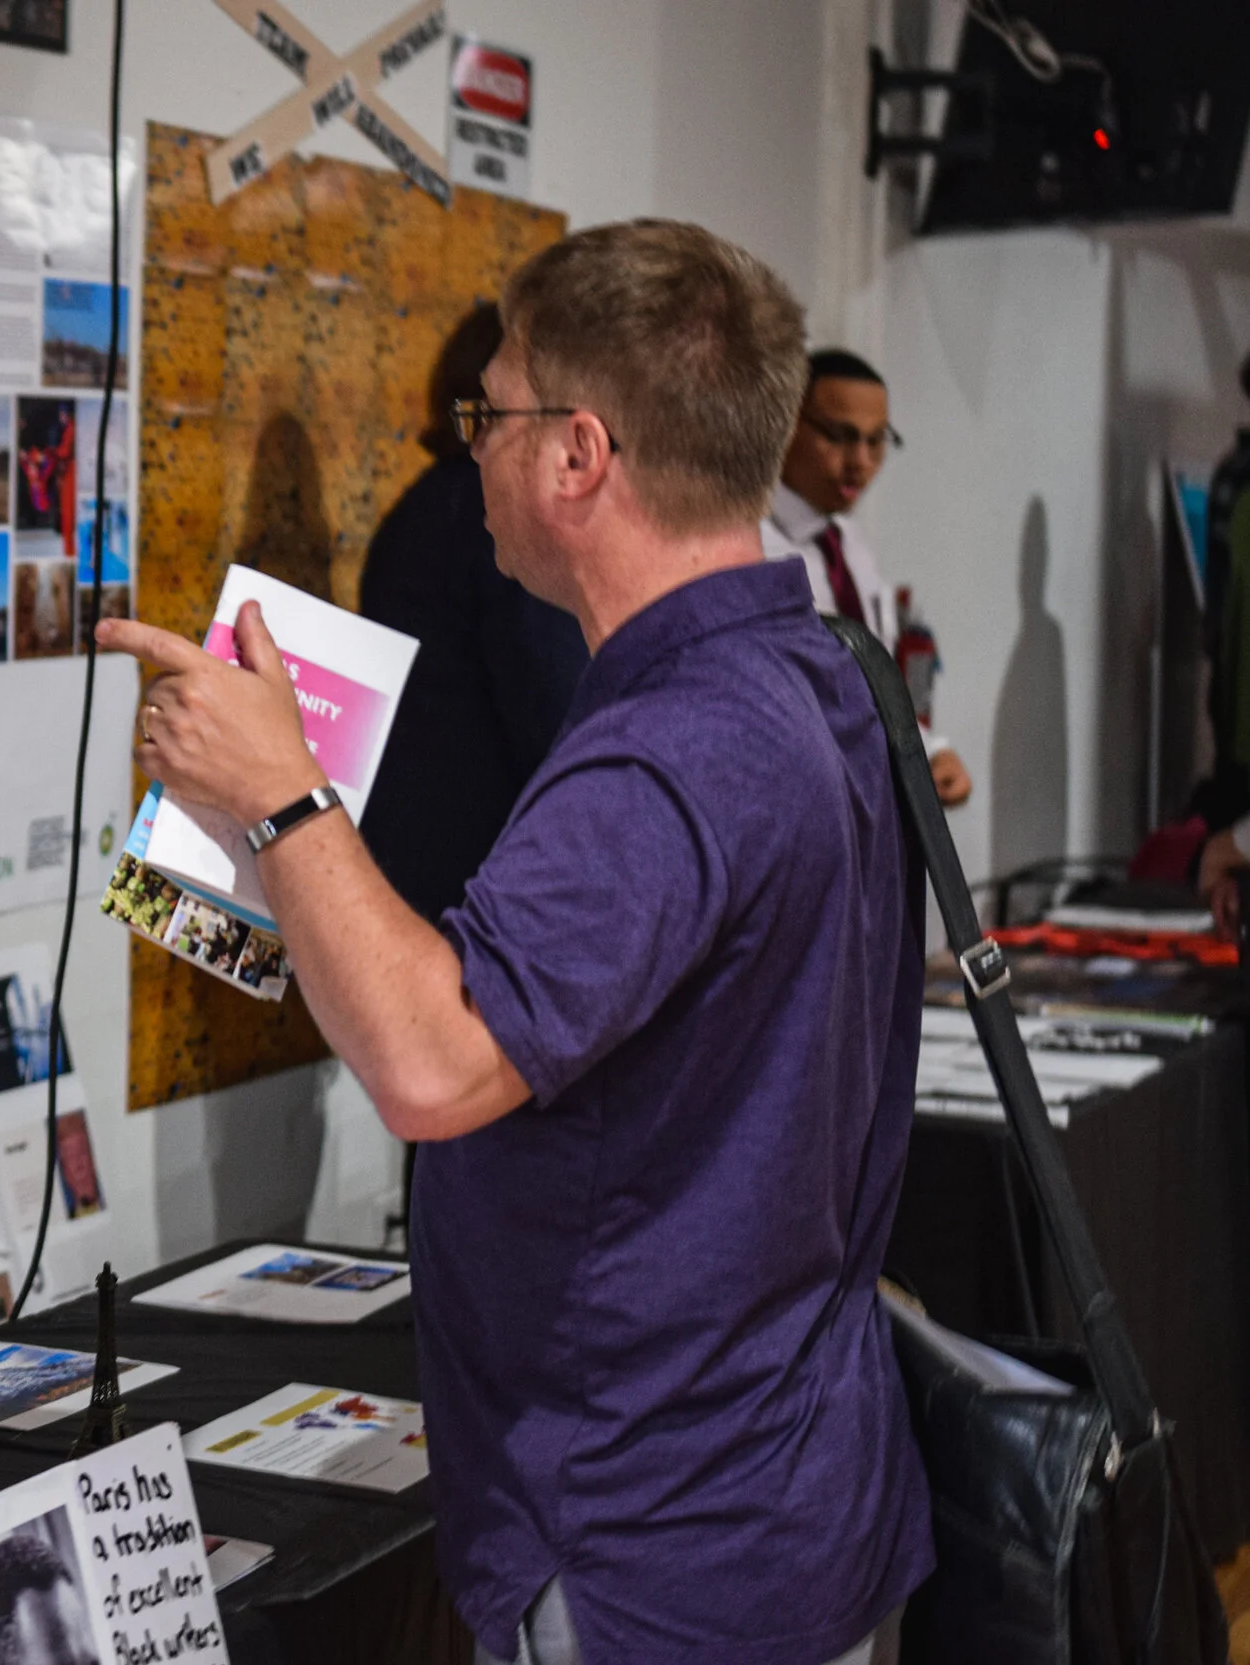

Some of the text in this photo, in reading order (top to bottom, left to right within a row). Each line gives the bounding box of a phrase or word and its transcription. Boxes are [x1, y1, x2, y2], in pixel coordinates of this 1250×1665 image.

[78, 1465, 172, 1514] Paris has
[92, 1513, 196, 1561] a tradition
[104, 1561, 203, 1619] of excellent
[113, 1612, 220, 1665] Black writers
